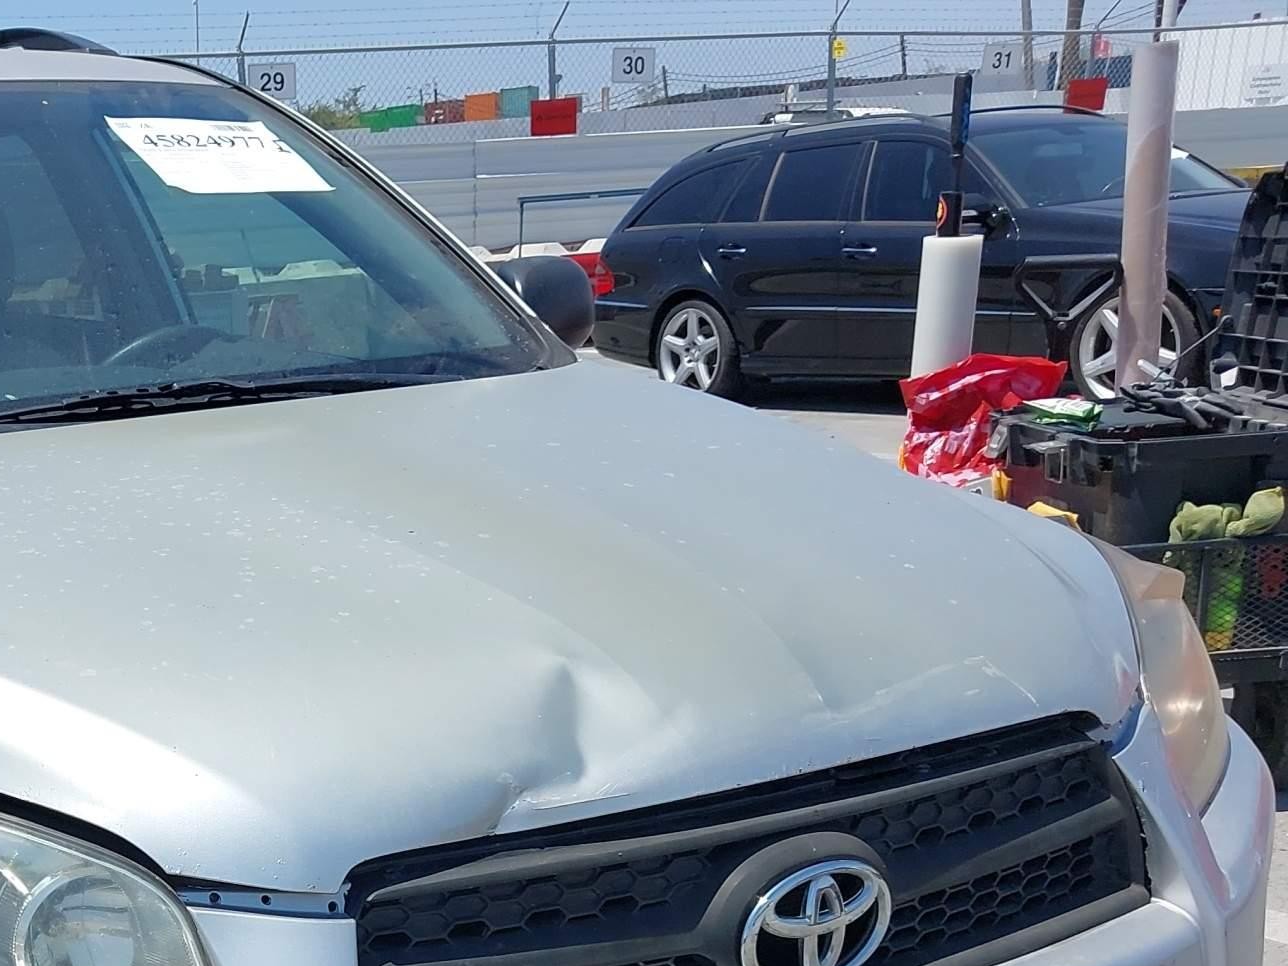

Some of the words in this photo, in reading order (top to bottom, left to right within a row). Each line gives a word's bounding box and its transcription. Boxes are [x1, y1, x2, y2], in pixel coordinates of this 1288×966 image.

[623, 56, 645, 75] 30
[992, 51, 1012, 69] 31
[260, 72, 285, 92] 29
[142, 134, 265, 149] 45824977
